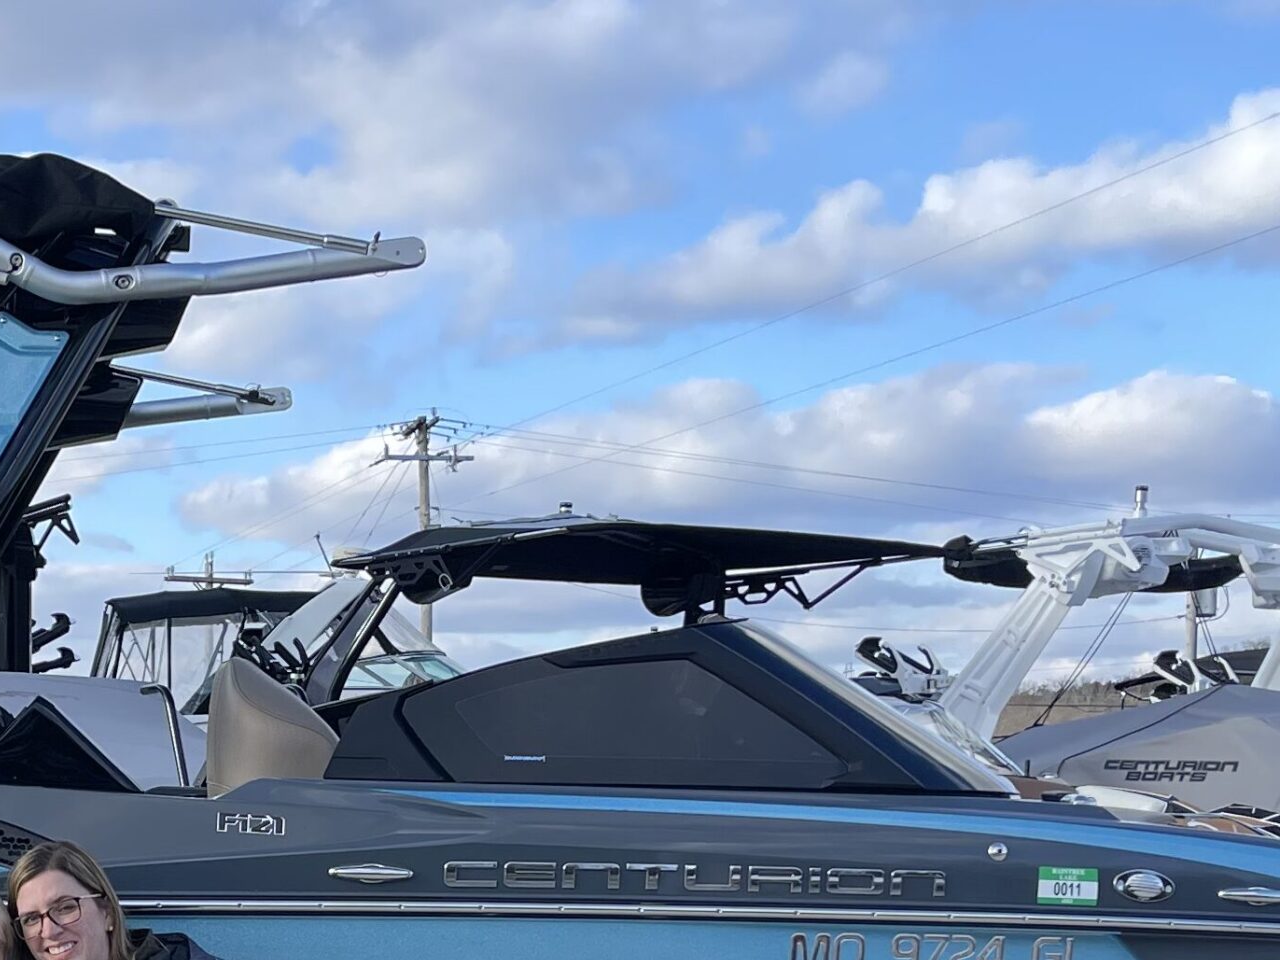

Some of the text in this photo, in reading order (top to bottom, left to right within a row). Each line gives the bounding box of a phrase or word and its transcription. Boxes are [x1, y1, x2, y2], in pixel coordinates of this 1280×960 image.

[1103, 759, 1239, 772] CENTURION
[1124, 771, 1208, 783] BOATS
[442, 859, 947, 898] CENTURION
[1053, 882, 1082, 897] 0011
